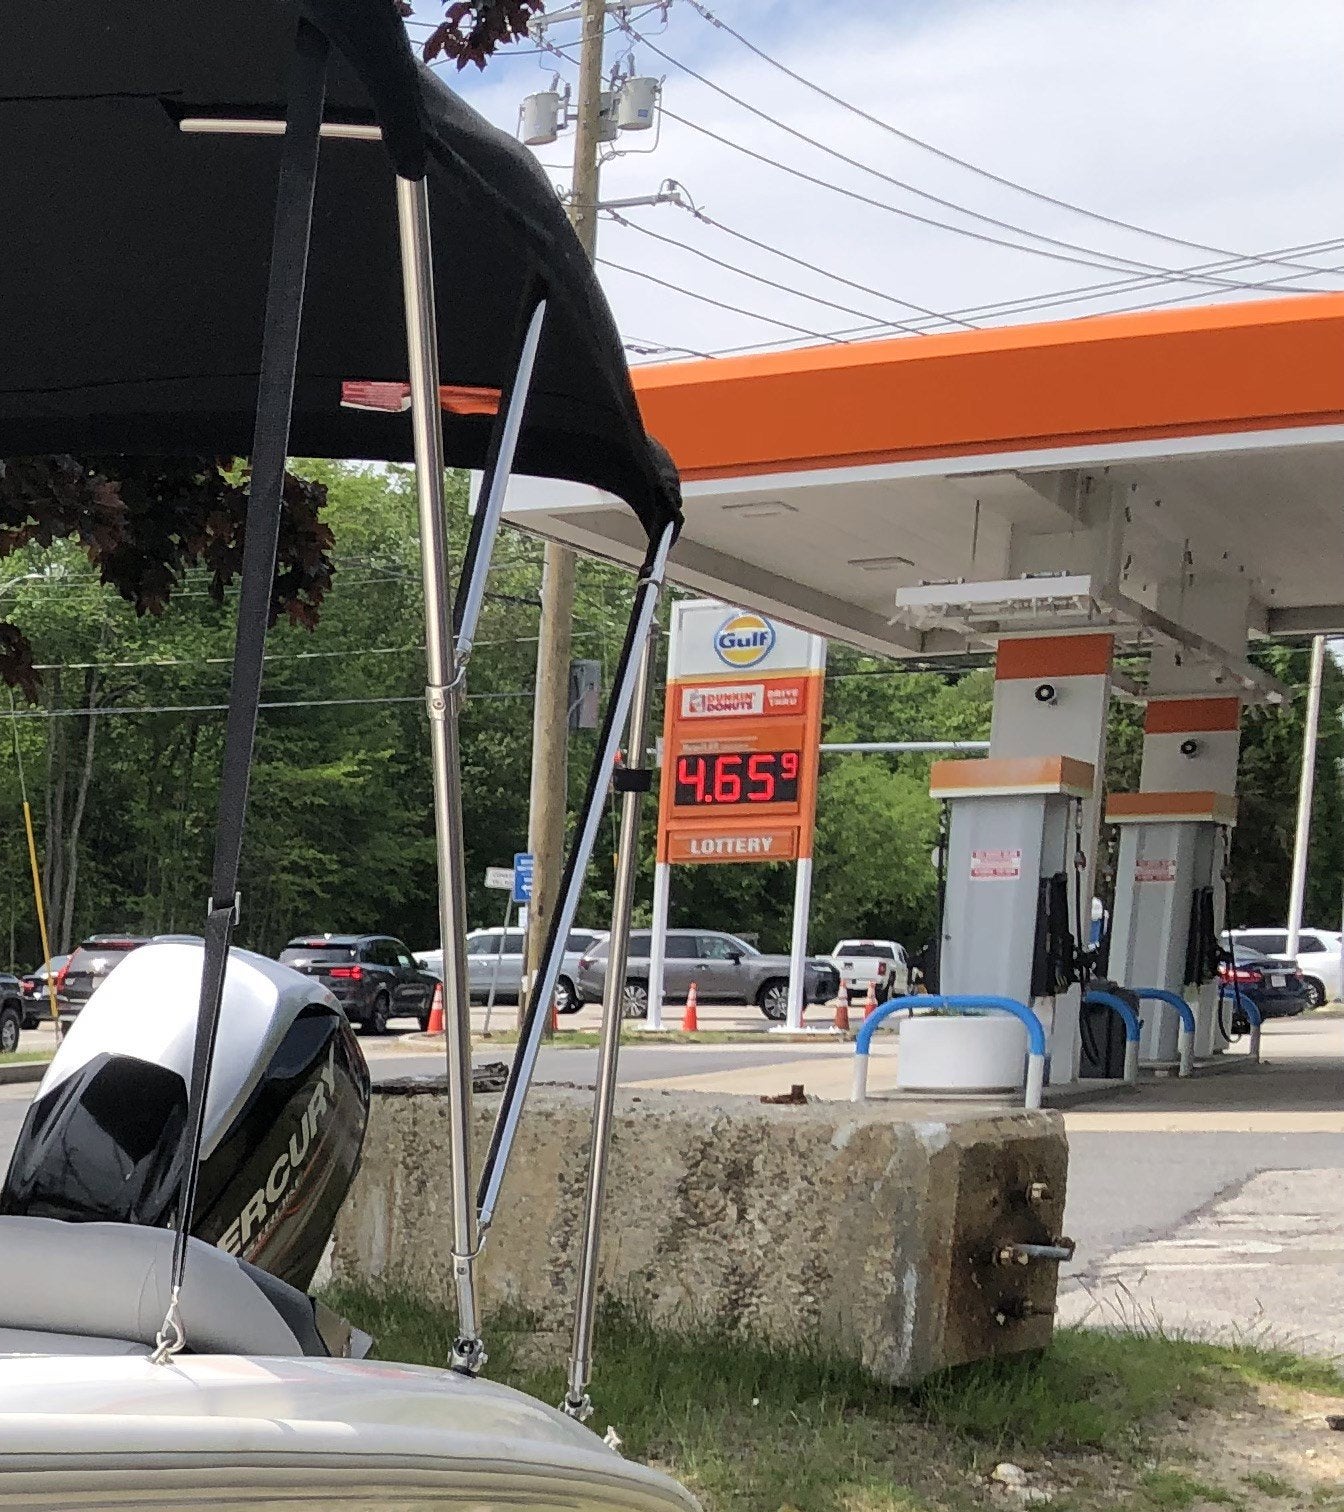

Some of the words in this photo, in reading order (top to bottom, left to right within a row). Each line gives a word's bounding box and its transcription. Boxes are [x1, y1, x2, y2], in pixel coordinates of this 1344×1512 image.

[718, 630, 769, 650] Gulf
[767, 687, 799, 699] DRIVE
[706, 701, 753, 712] DONUTS
[690, 837, 773, 855] LOTTERY
[216, 1041, 336, 1258] ERCURY
